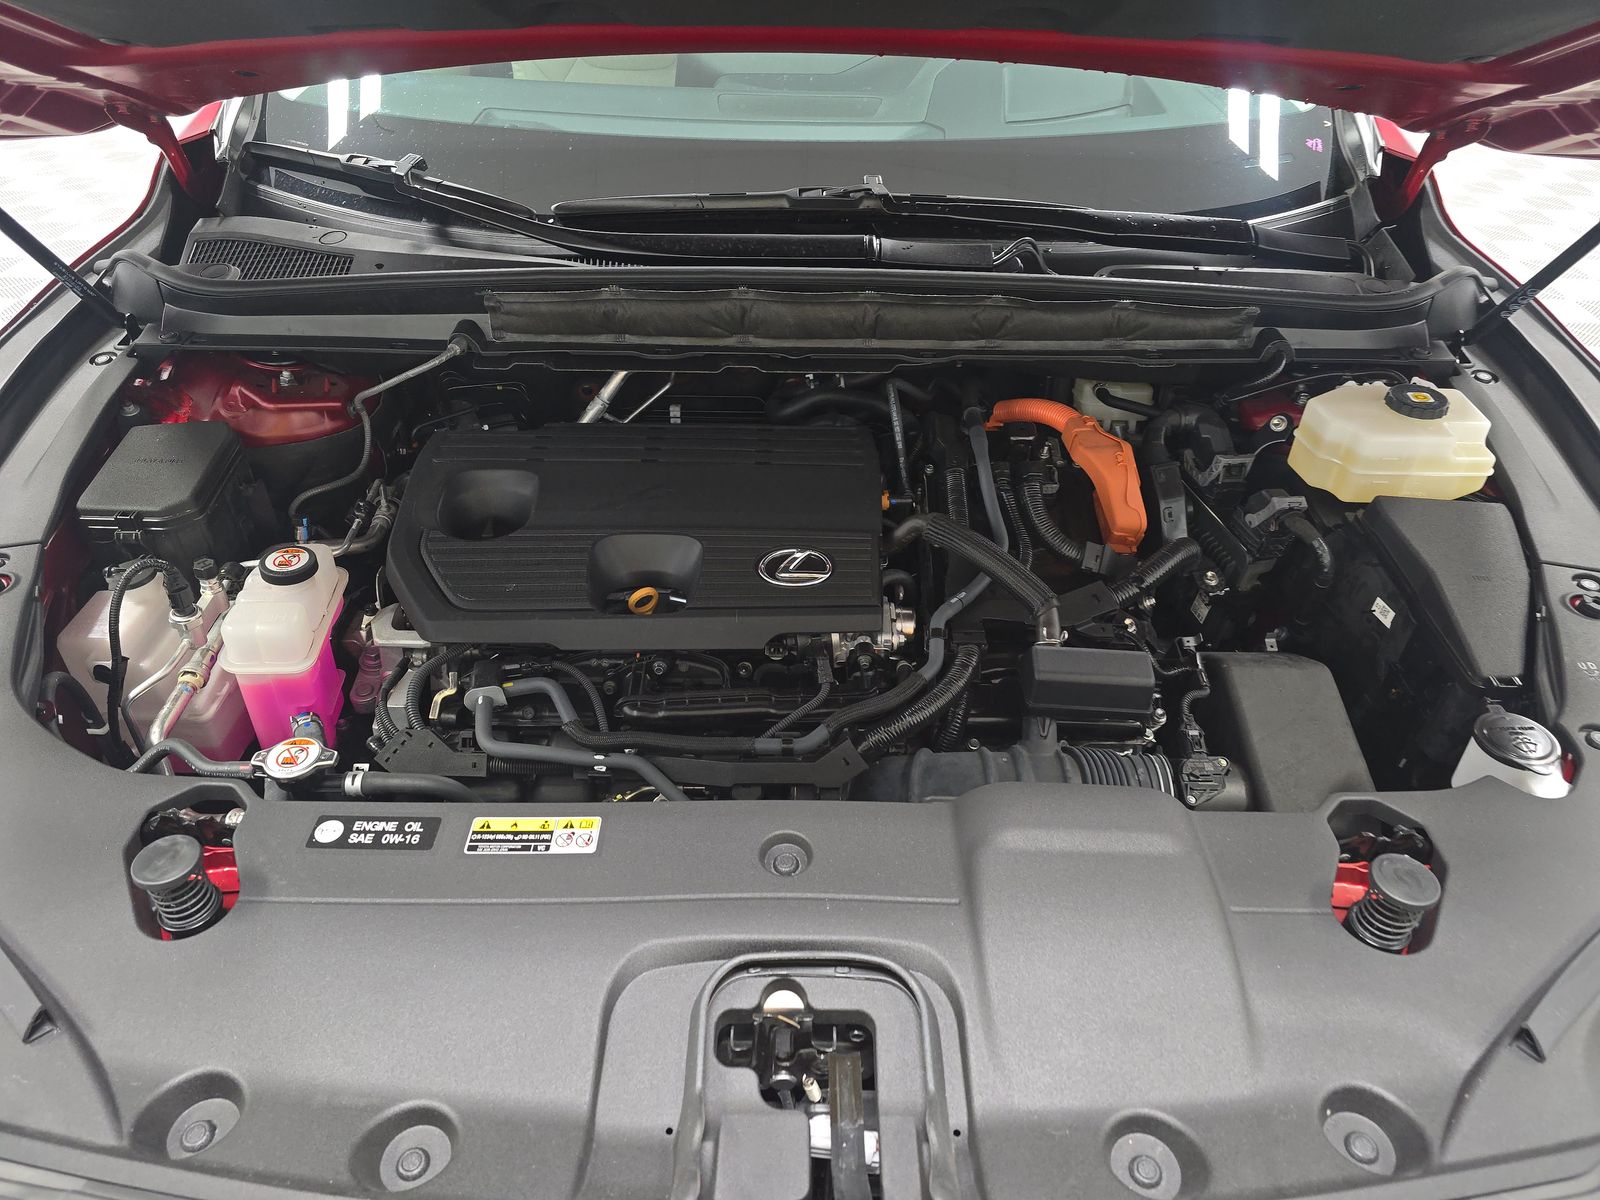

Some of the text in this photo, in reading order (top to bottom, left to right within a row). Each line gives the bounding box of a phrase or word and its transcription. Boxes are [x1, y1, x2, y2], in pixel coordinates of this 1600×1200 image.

[352, 821, 424, 832] ENGINE OIL
[348, 833, 421, 844] SAE 0W-16
